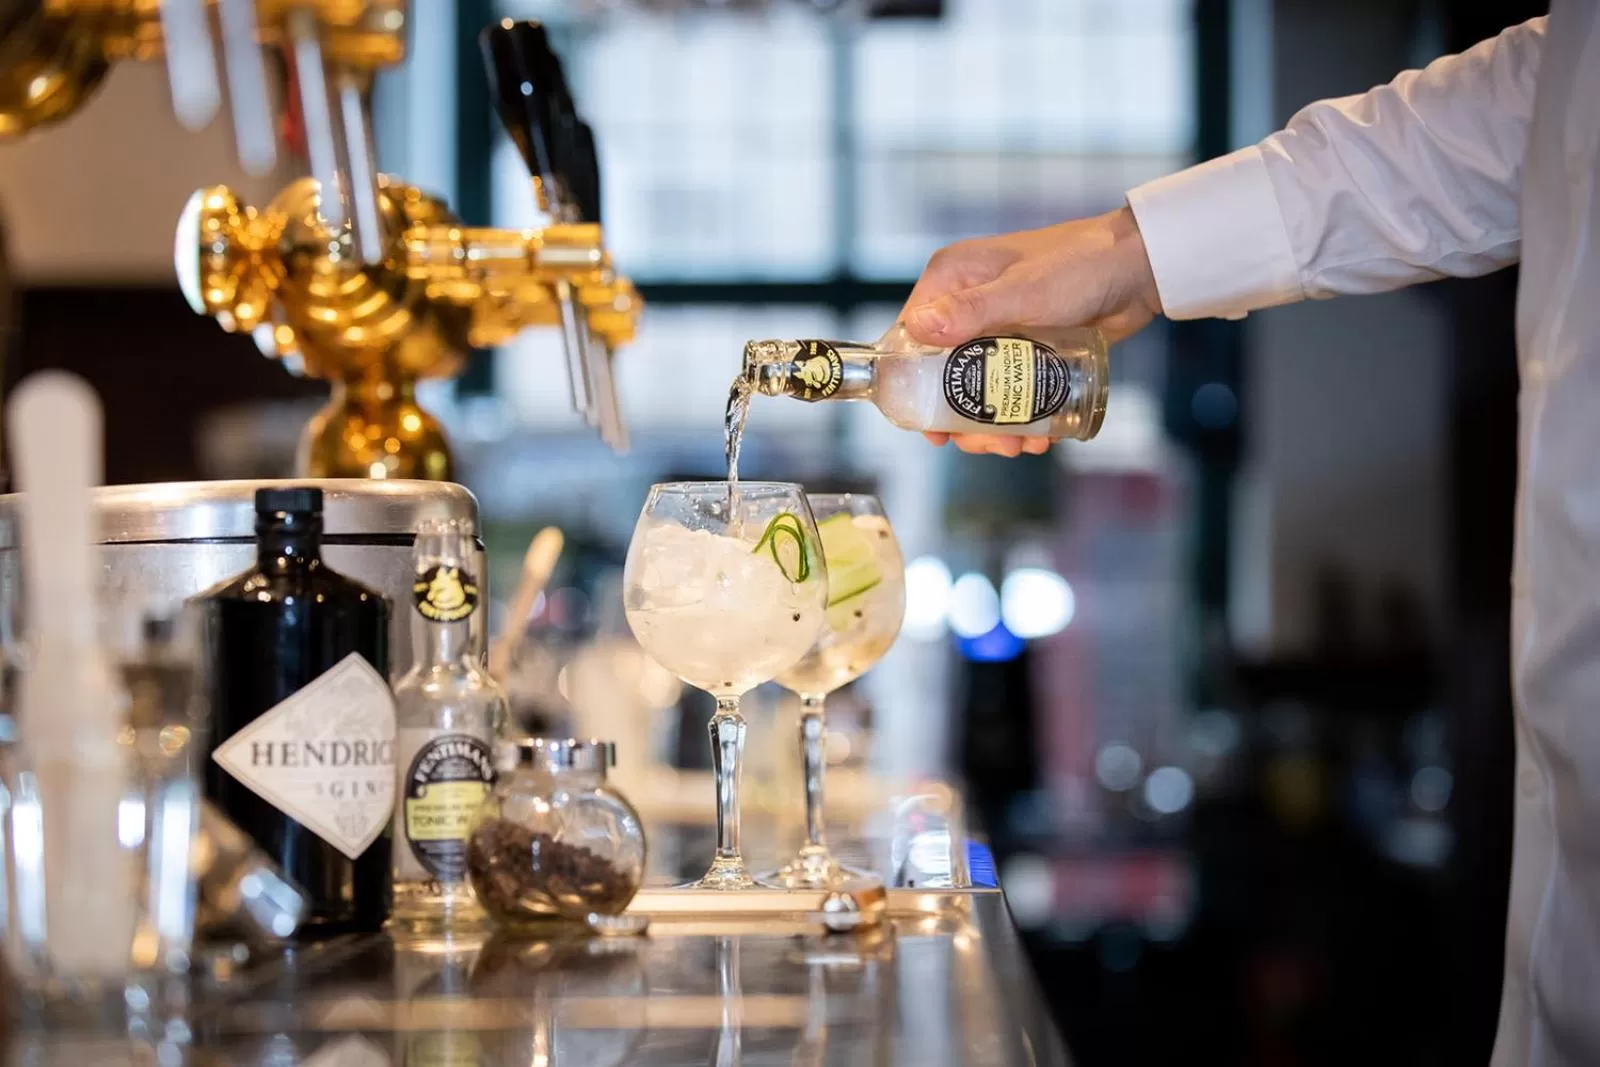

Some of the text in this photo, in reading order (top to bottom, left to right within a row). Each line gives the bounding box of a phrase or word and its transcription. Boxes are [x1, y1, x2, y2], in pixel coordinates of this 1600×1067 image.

[951, 344, 984, 415] FENTIMANS
[1001, 344, 1011, 417] PREMIUM INDIAN
[1010, 341, 1024, 418] TONIC WATER
